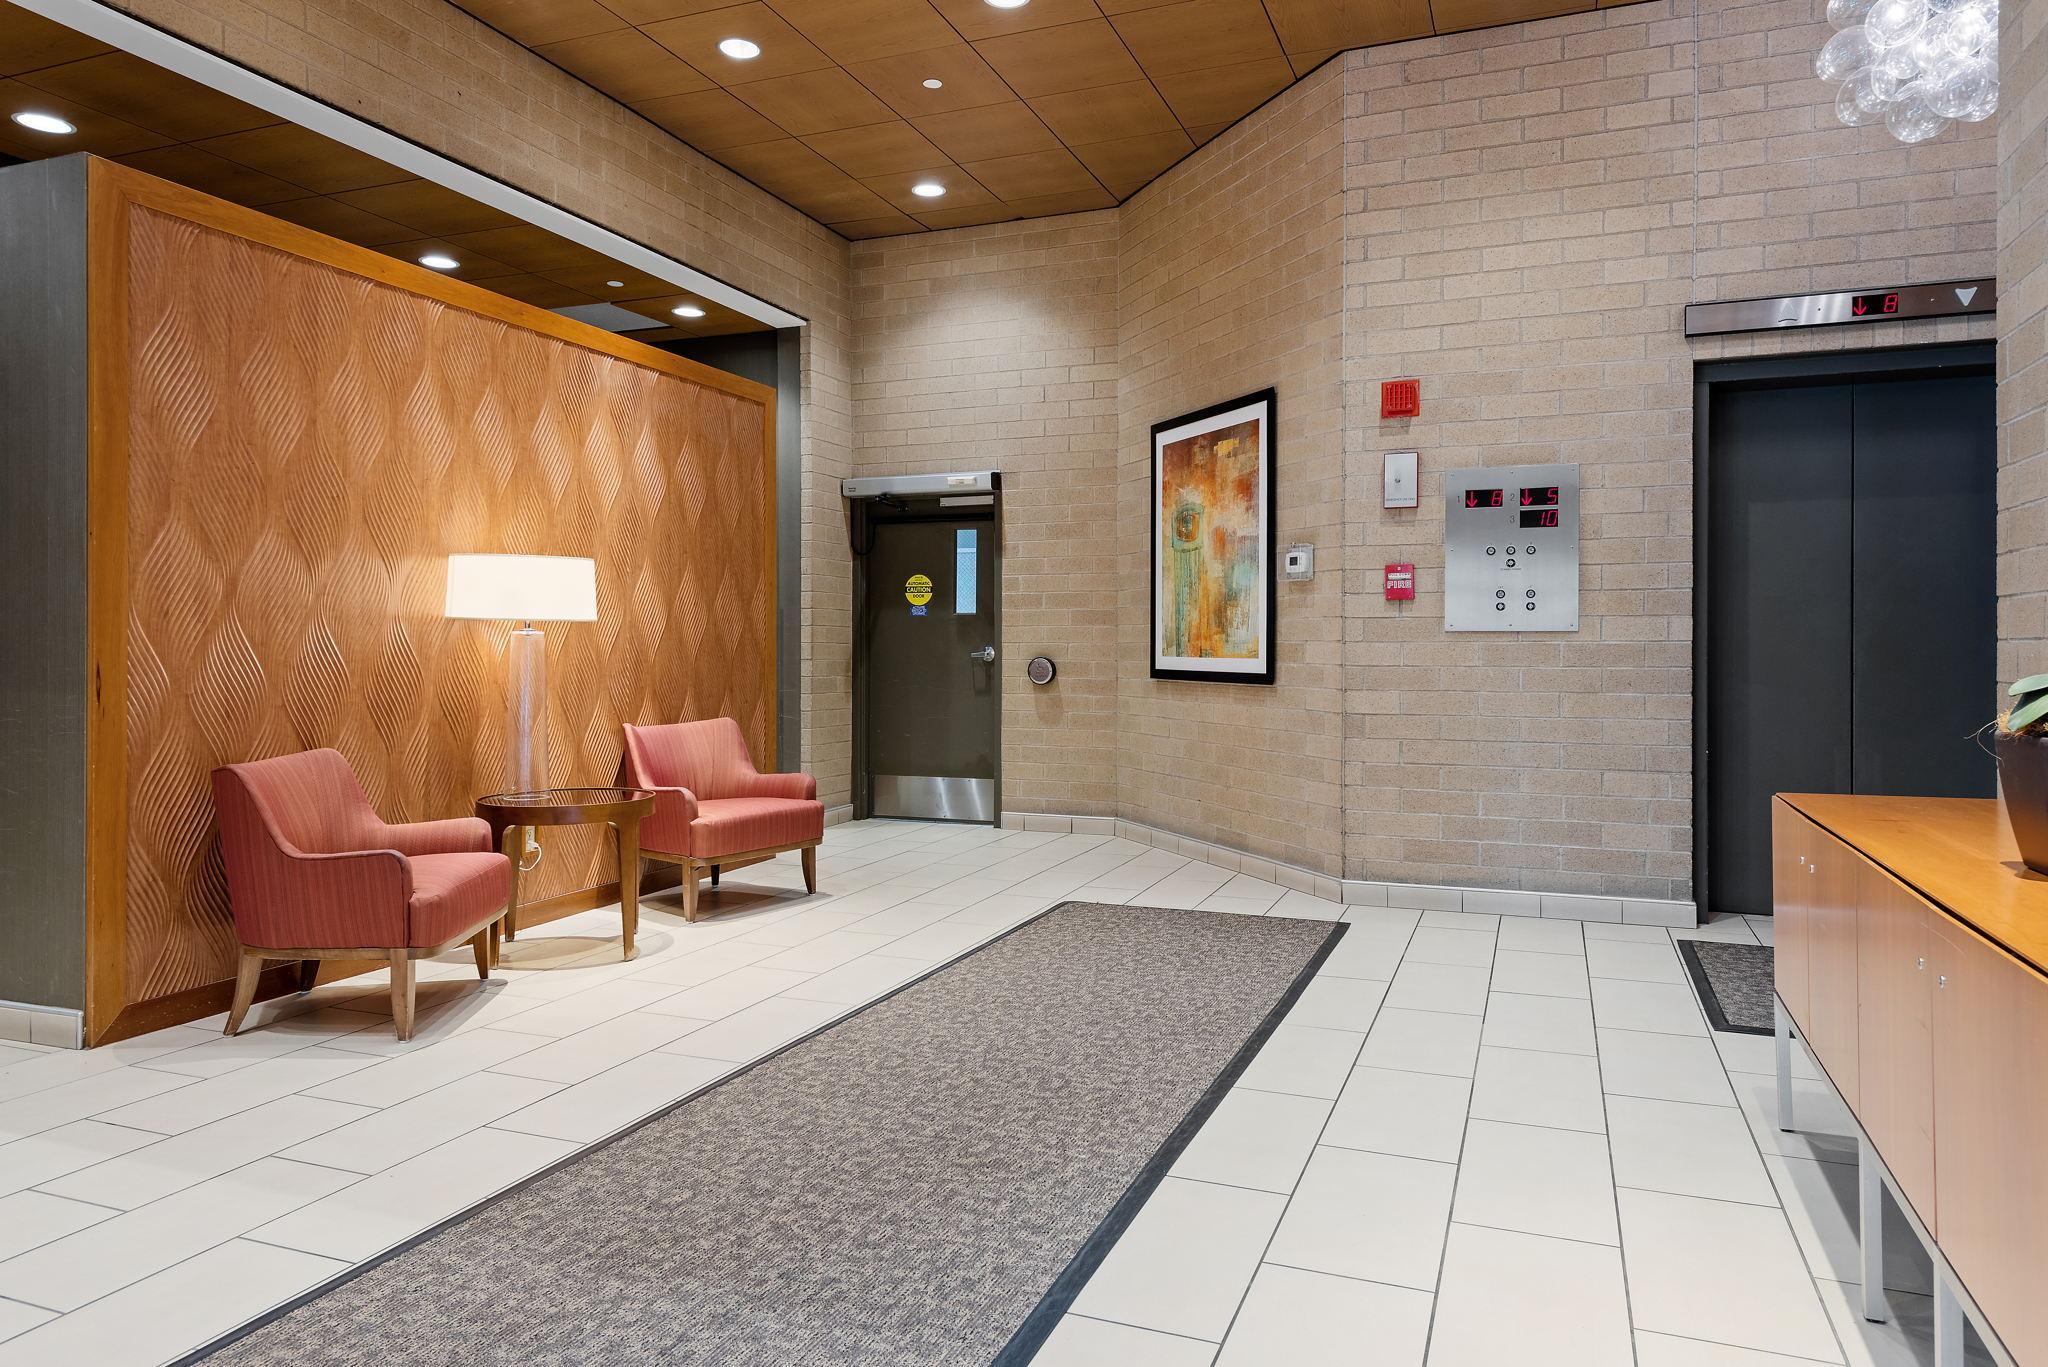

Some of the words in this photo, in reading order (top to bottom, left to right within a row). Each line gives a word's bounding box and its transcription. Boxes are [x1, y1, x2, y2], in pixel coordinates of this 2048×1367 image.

[1884, 294, 1898, 312] 8
[1491, 490, 1503, 506] 8
[1510, 493, 1515, 501] 2
[1547, 488, 1558, 504] 5
[1510, 515, 1515, 523] 3
[1541, 510, 1558, 526] 10
[1387, 580, 1411, 588] FIRE
